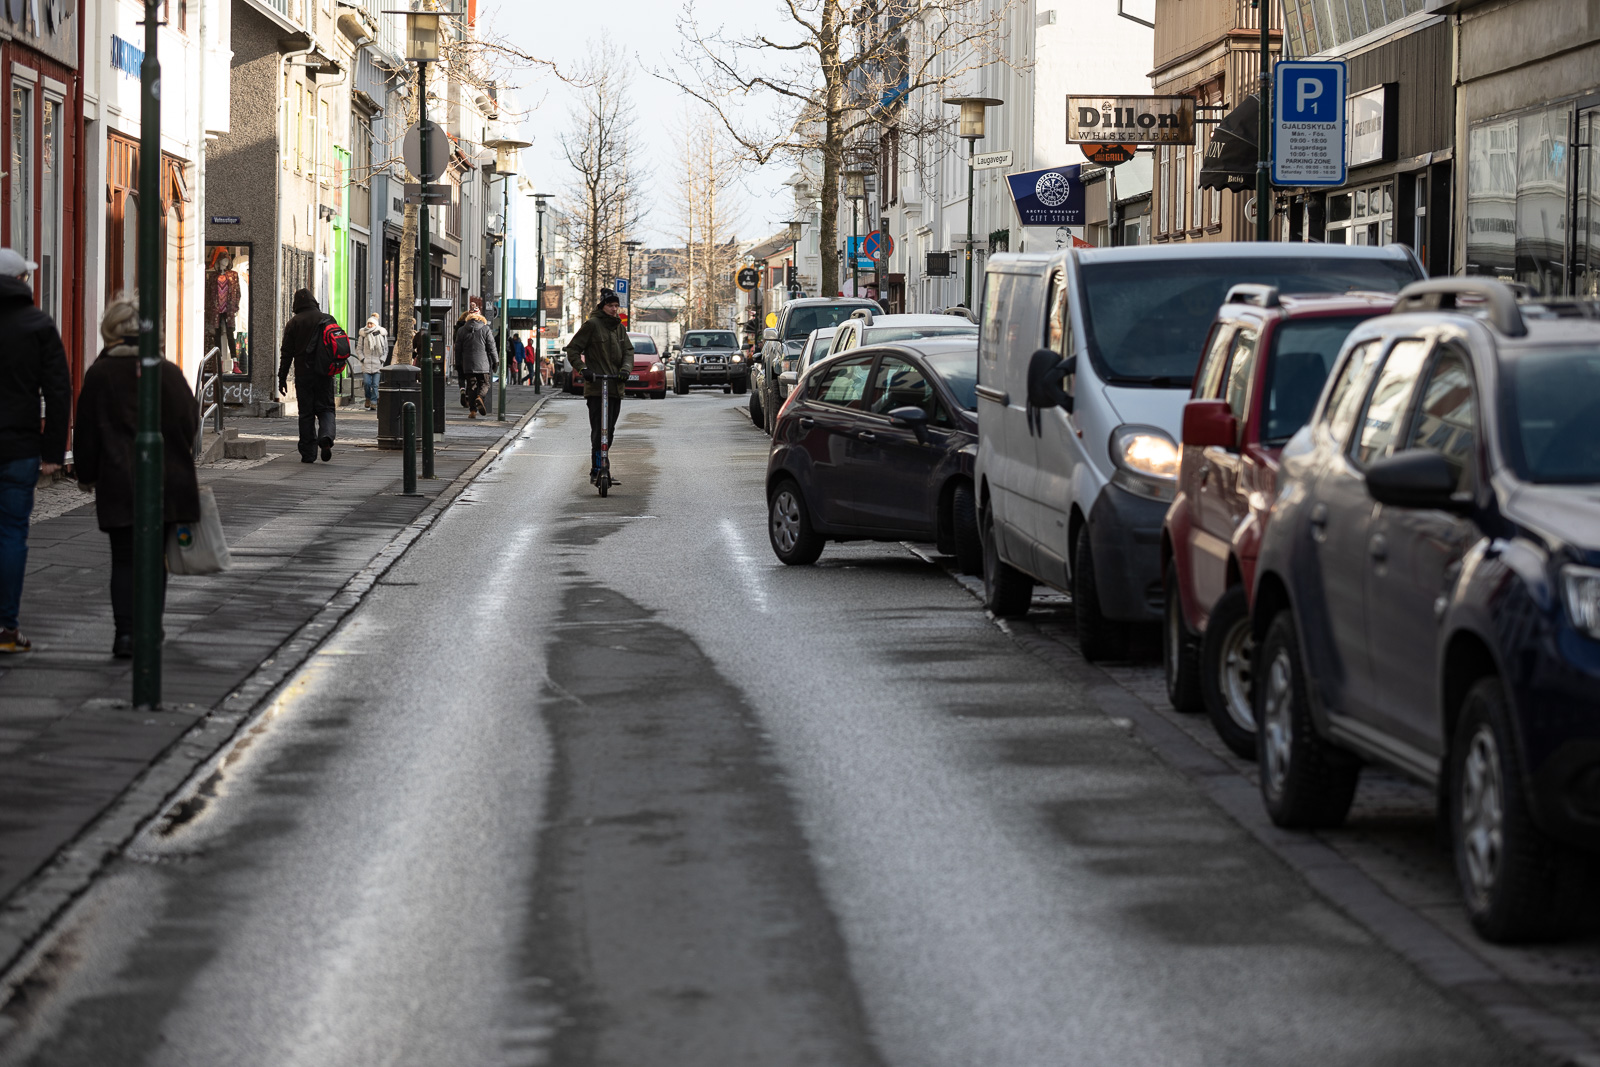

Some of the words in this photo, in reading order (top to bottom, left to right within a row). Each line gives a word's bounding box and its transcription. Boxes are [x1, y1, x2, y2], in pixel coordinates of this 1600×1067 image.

[1296, 77, 1324, 113] P
[1310, 101, 1318, 115] 1
[1078, 105, 1180, 129] Dillon
[1078, 131, 1146, 141] WHISKEY
[1152, 131, 1180, 141] BAR
[1206, 141, 1226, 159] ON
[977, 154, 1009, 166] Laugavegur
[1105, 153, 1124, 162] GRILL
[618, 281, 625, 291] P
